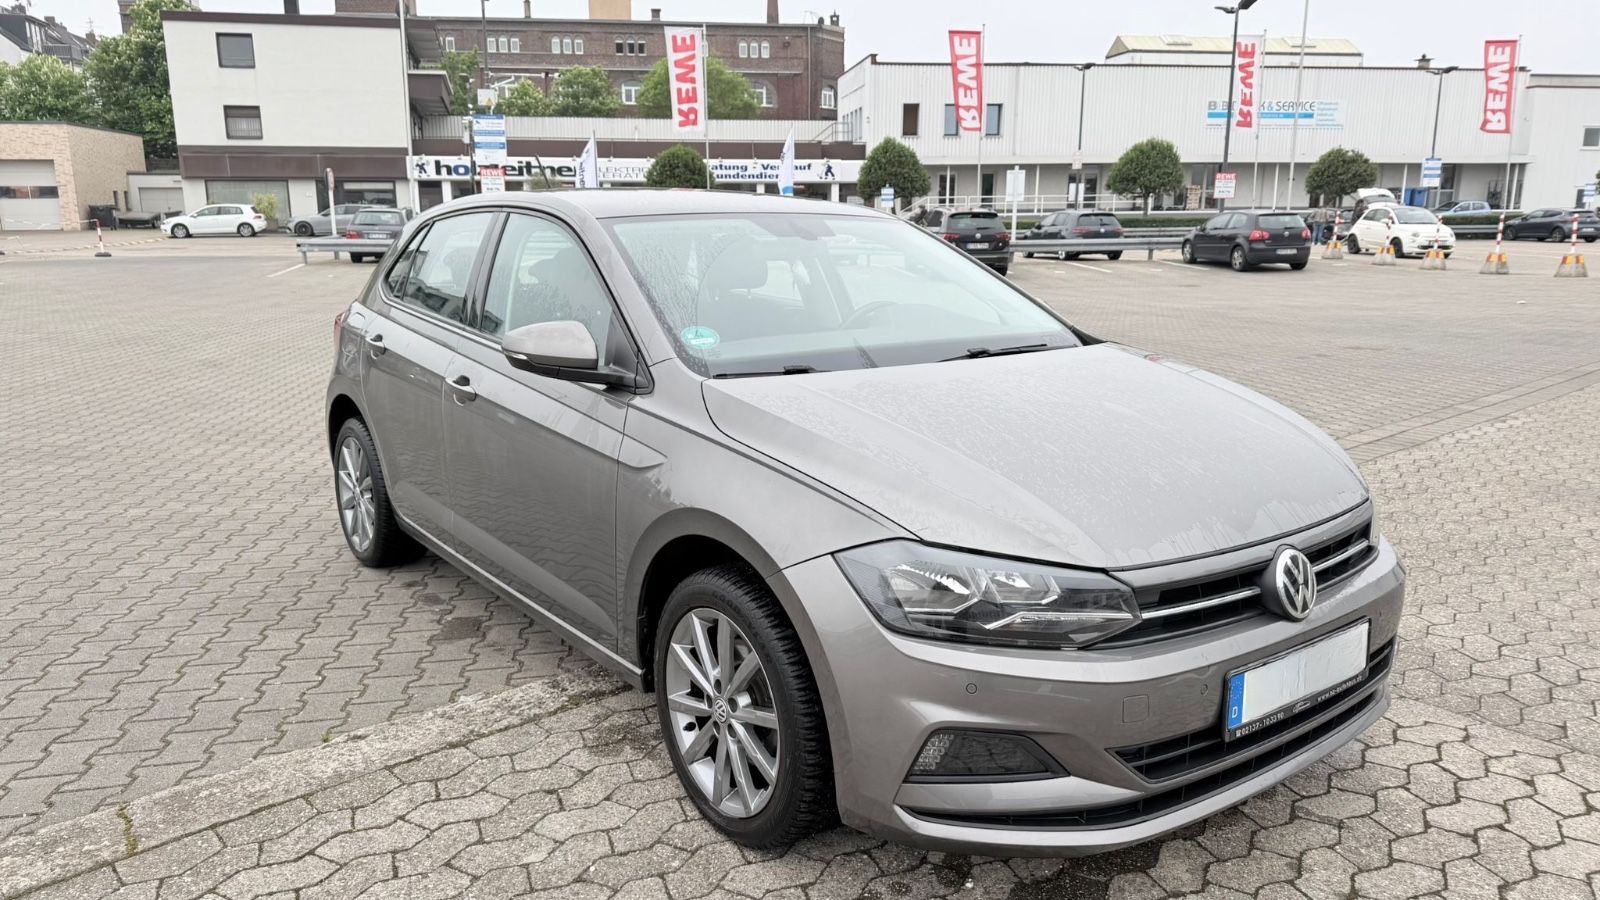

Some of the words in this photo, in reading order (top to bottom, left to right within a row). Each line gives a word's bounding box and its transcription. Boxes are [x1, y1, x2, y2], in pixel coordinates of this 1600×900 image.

[1276, 101, 1316, 111] SERVICE
[435, 160, 577, 178] holeitne
[481, 168, 504, 176] REWE
[711, 164, 748, 172] atung
[1232, 706, 1238, 718] D
